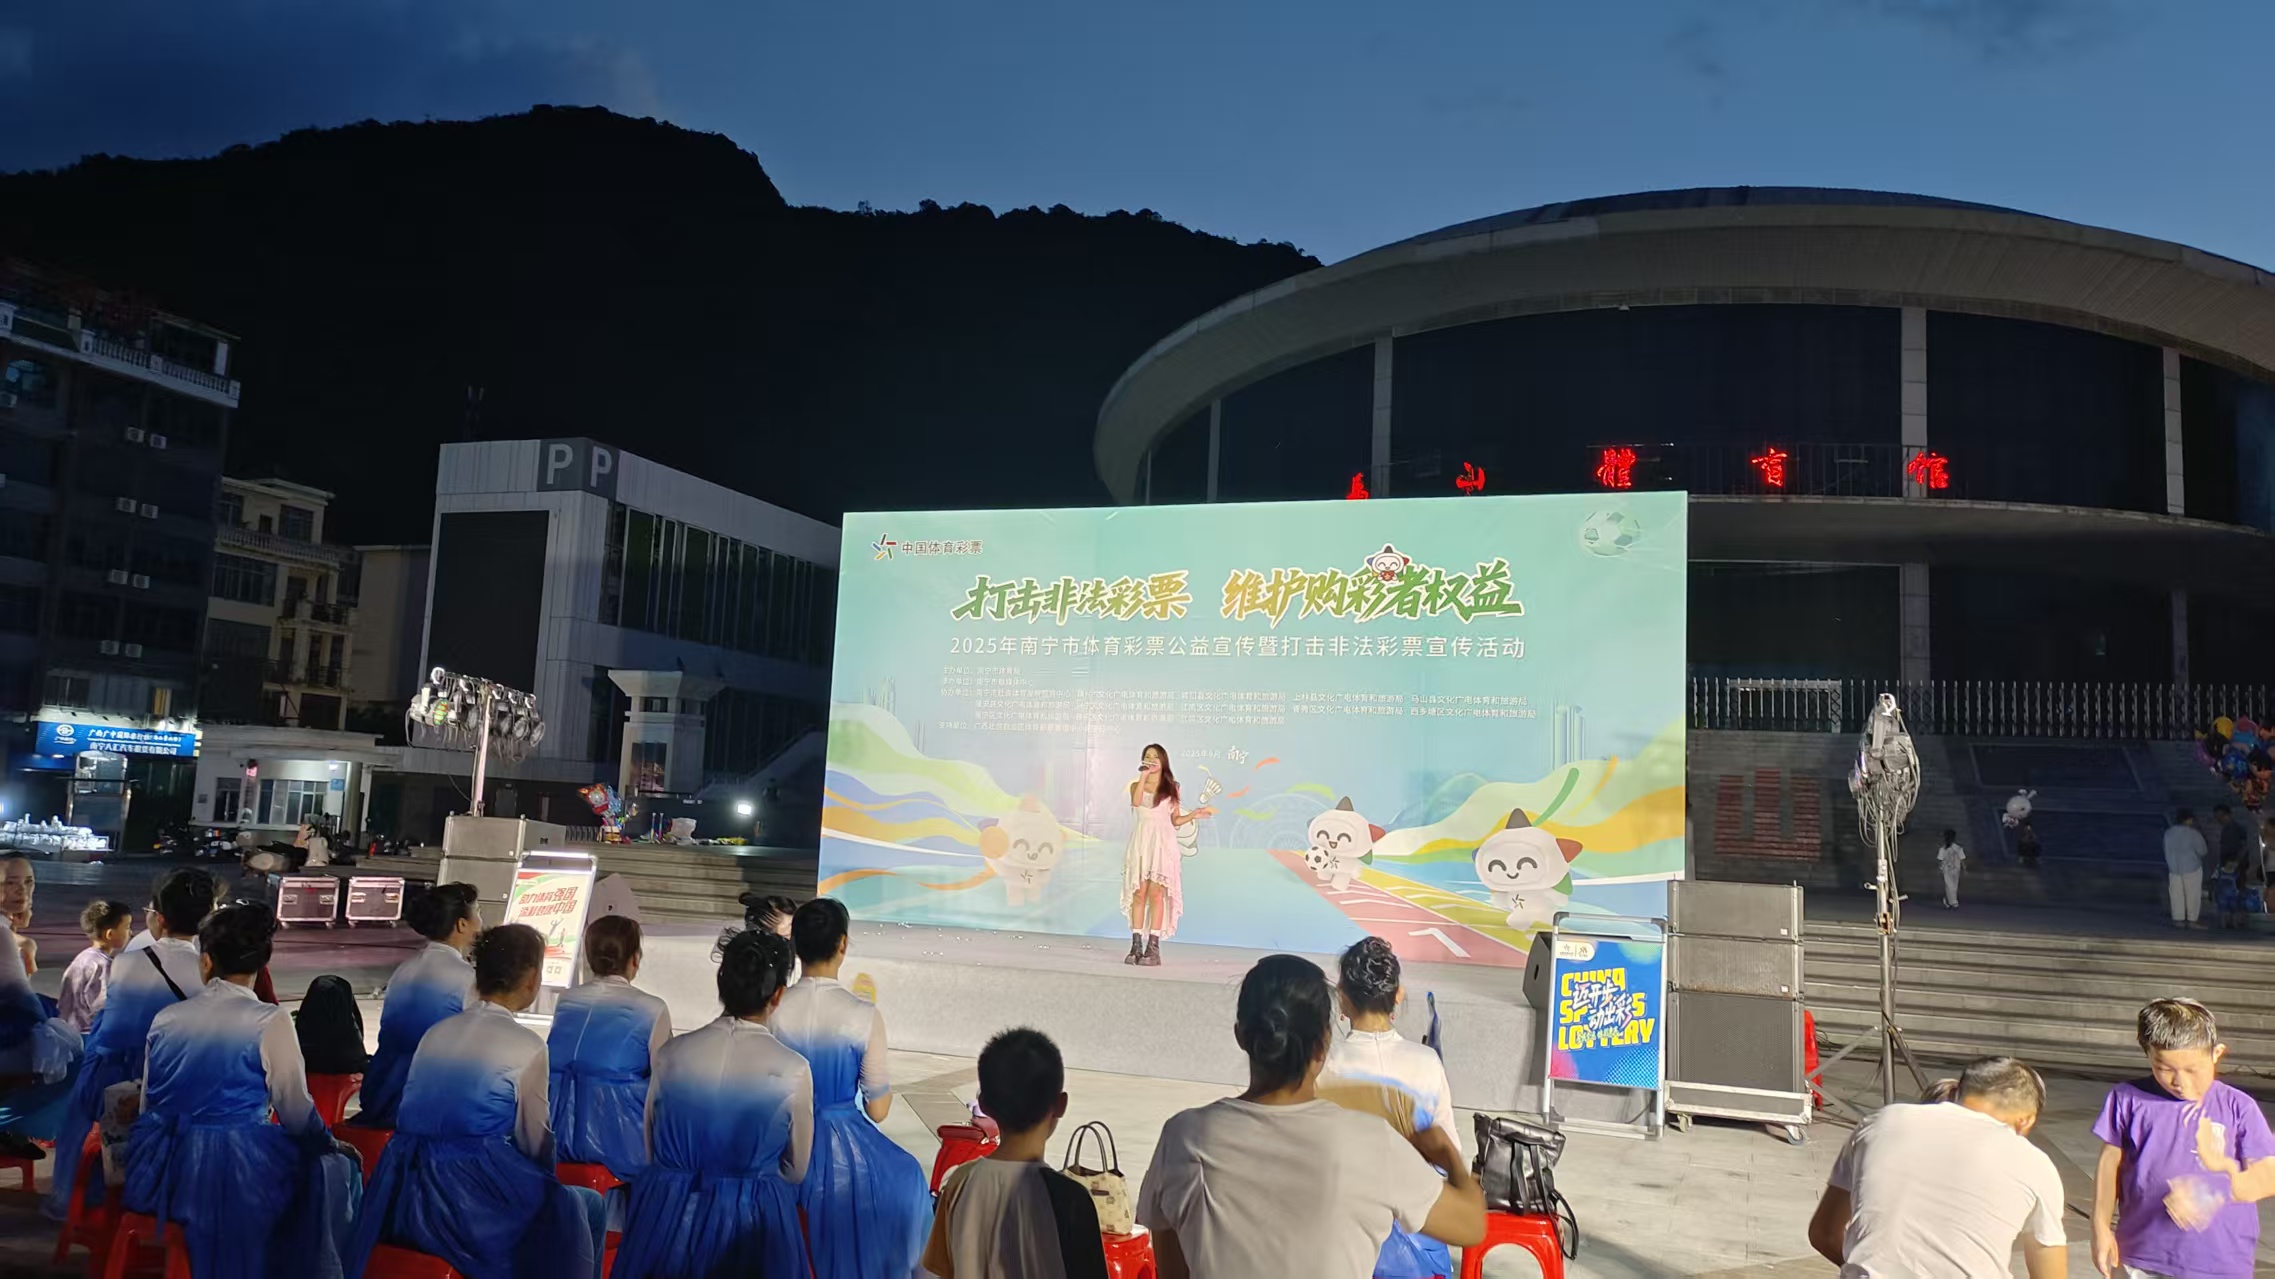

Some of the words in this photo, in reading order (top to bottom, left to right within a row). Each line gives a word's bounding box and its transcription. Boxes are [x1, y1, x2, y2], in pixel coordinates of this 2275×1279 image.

[546, 443, 573, 484] P
[590, 445, 612, 488] P
[901, 540, 983, 555] 中国体育彩票
[951, 570, 1192, 626] 打击非法彩票
[1220, 557, 1524, 628] 维护购彩者权益
[950, 635, 1525, 658] 2025年南宁市体育彩票公益宣传暨打击非法彩票宣传活动
[1560, 992, 1645, 1024] SPS
[1572, 978, 1619, 1009] 迈开步
[1587, 992, 1632, 1031] 动出彩
